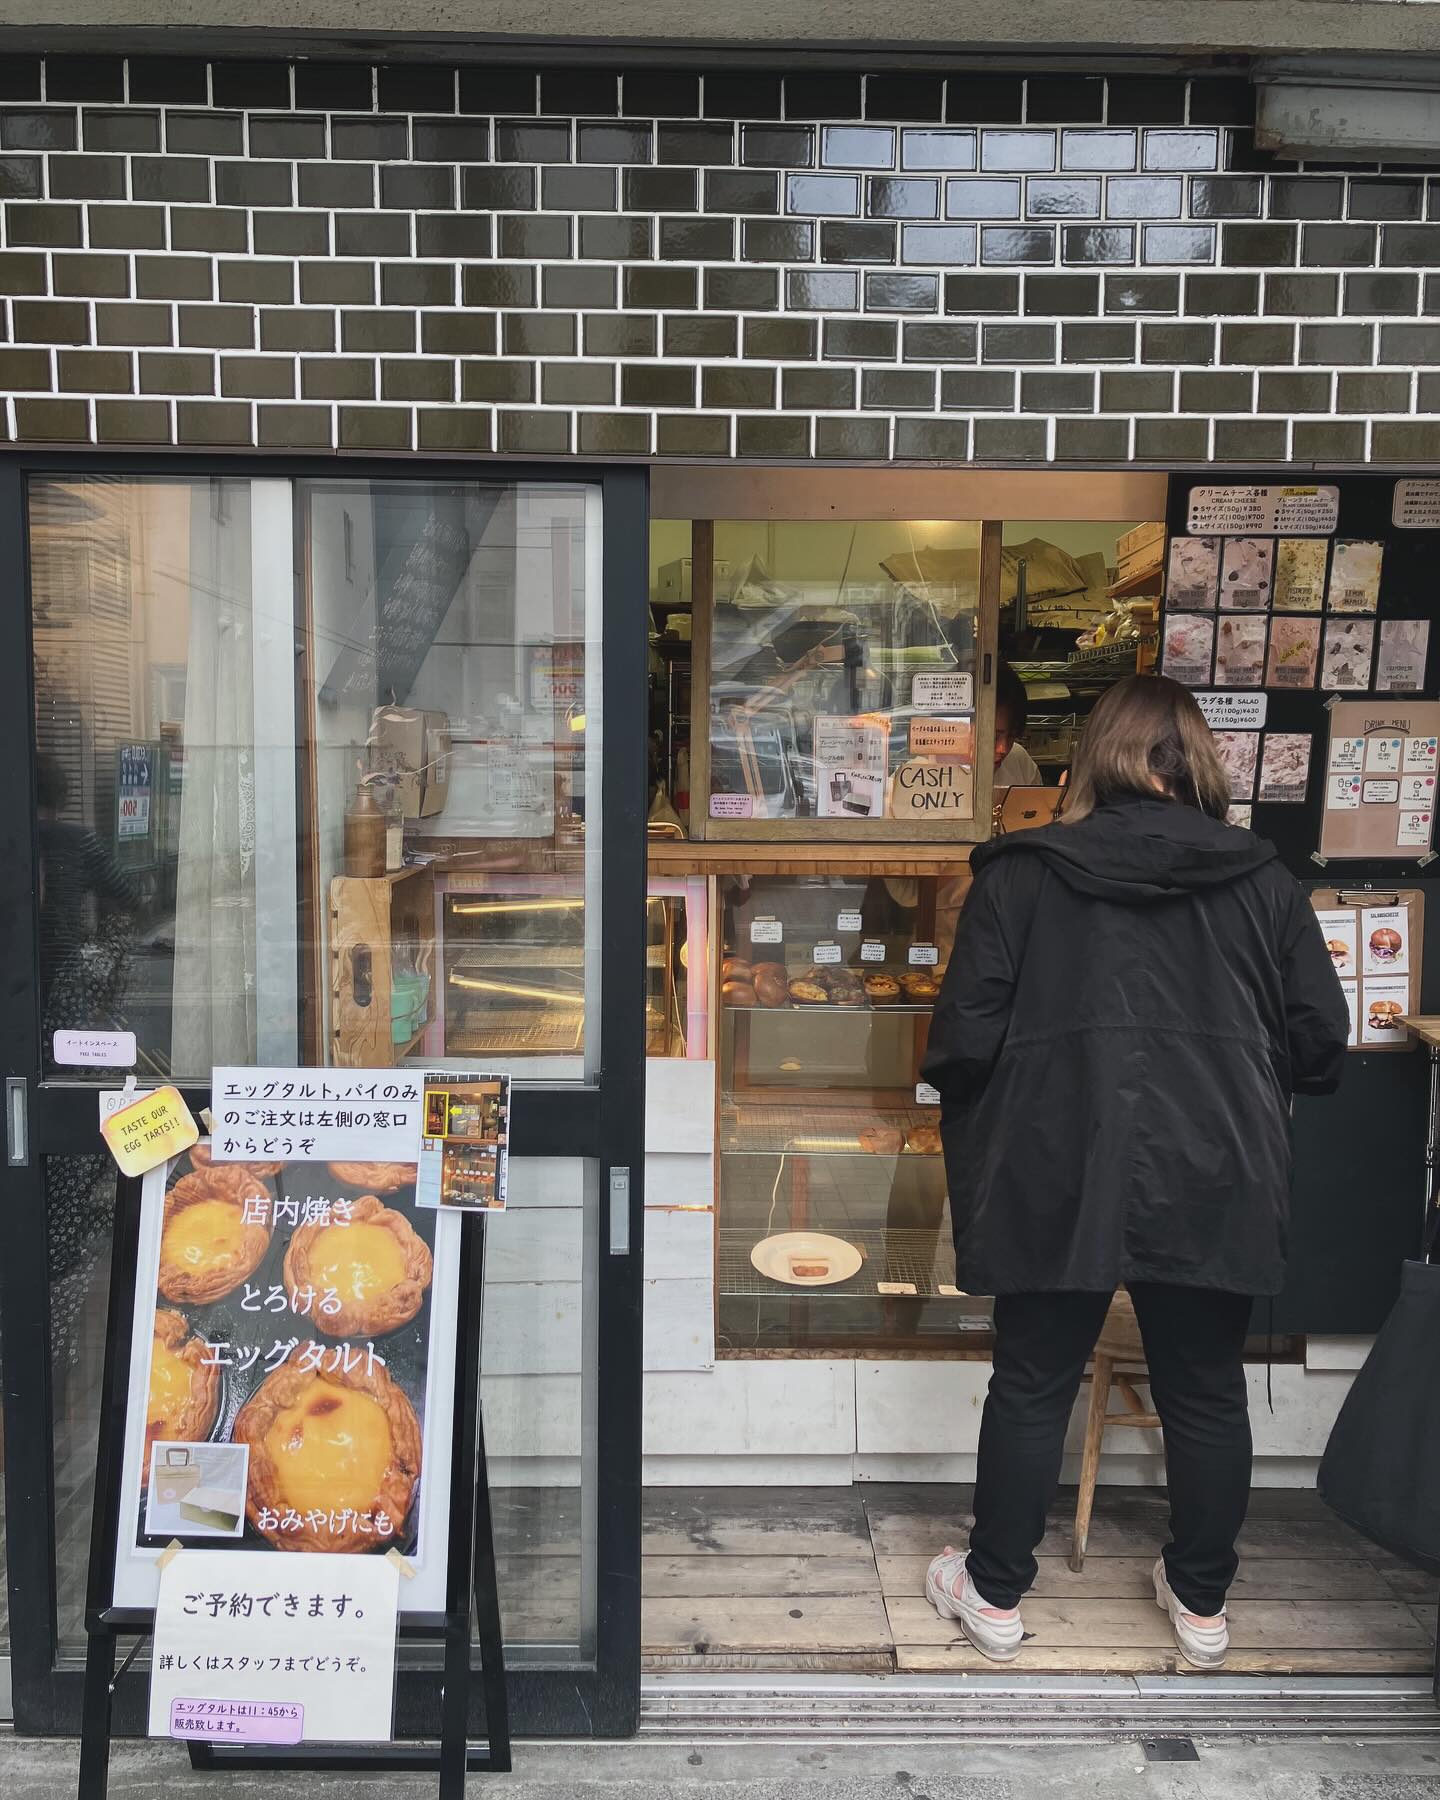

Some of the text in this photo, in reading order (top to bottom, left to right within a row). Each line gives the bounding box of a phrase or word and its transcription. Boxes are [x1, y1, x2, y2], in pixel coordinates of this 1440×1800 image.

[1199, 488, 1269, 497] クリームチーズ各種
[1391, 719, 1411, 730] MENU
[899, 767, 953, 789] CASH
[911, 791, 964, 810] ONLY
[65, 1039, 119, 1047] イートインスペース
[120, 1105, 169, 1136] TASTE OUR
[223, 1109, 407, 1129] のご注文は左側の窓口
[123, 1117, 181, 1154] EGG TARTS!!
[223, 1136, 316, 1156] からどうぞ
[239, 1195, 357, 1229] 店内焼き
[239, 1282, 344, 1315] とろける
[199, 1336, 387, 1378] エッグタルト
[257, 1506, 394, 1536] おみやげにも
[183, 1592, 364, 1619] ご予約できます。
[159, 1654, 368, 1673] 詳しくはスタッフまでどうぞ。
[174, 1717, 242, 1733] 販売致します。
